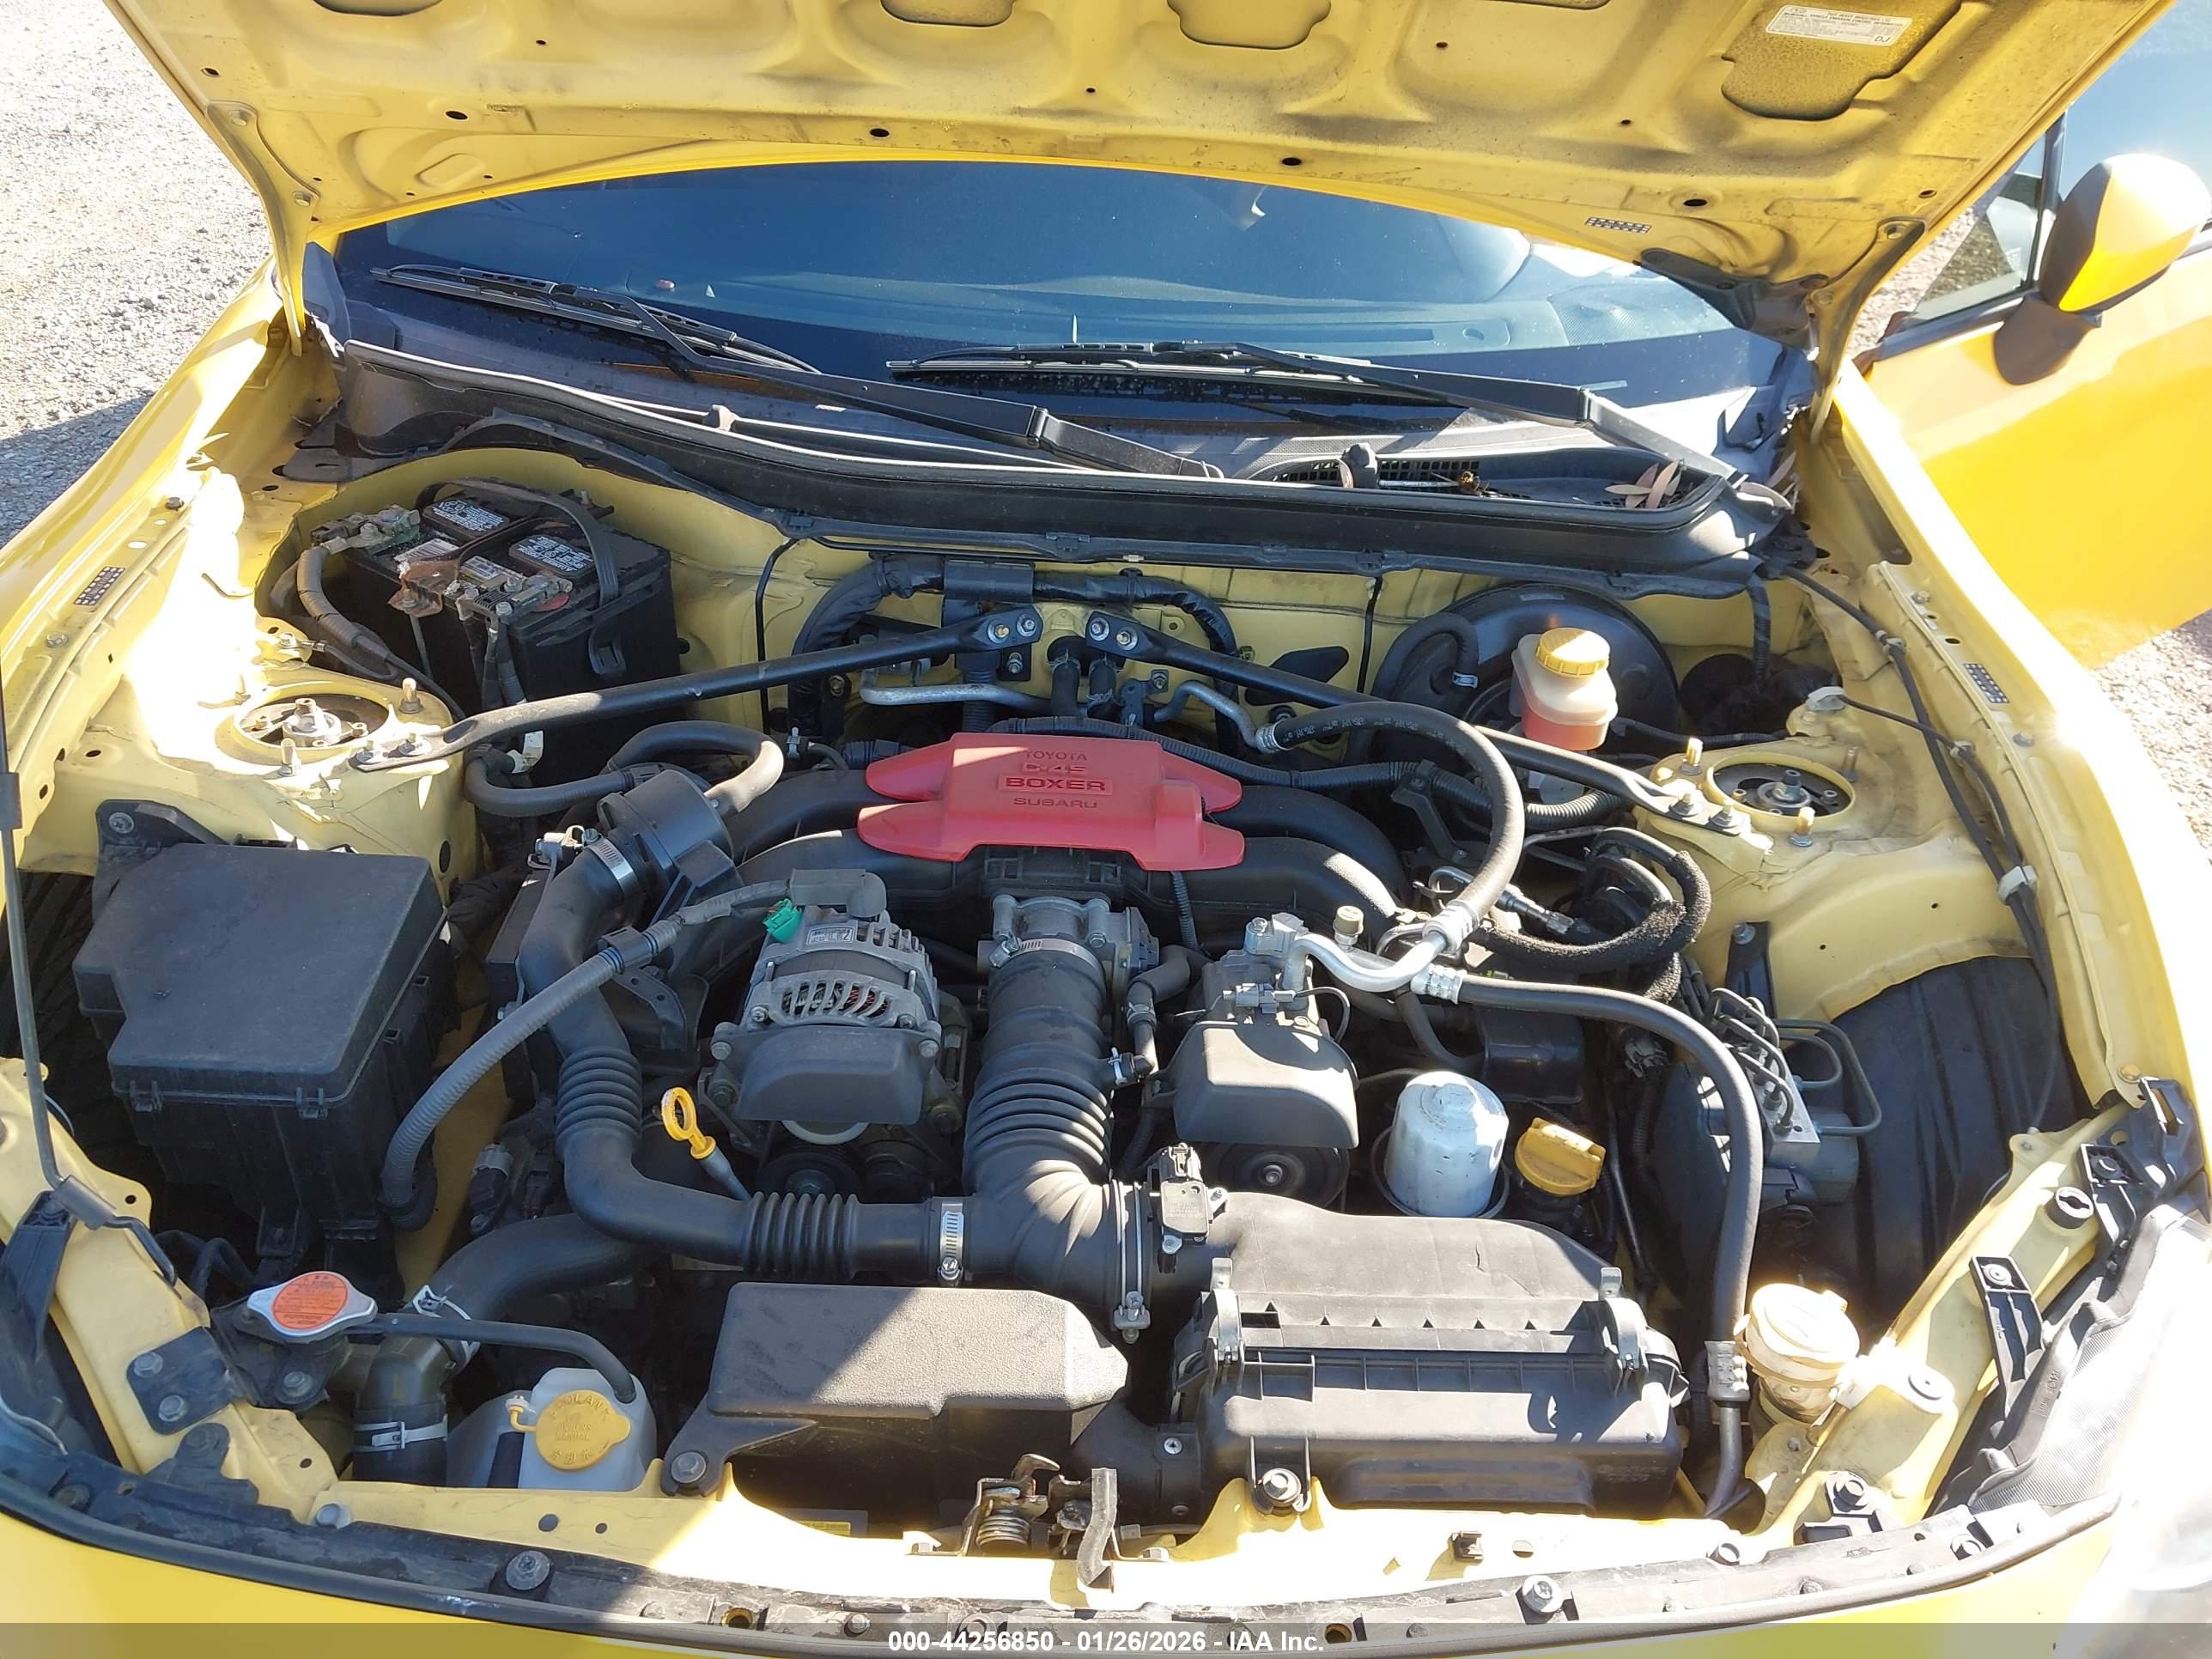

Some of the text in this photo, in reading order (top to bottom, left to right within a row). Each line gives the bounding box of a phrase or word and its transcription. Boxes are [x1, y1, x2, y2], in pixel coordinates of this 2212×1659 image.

[1025, 750, 1088, 761] TOYOTA
[1005, 777, 1107, 791] BOXER
[1013, 797, 1098, 809] SUBARU
